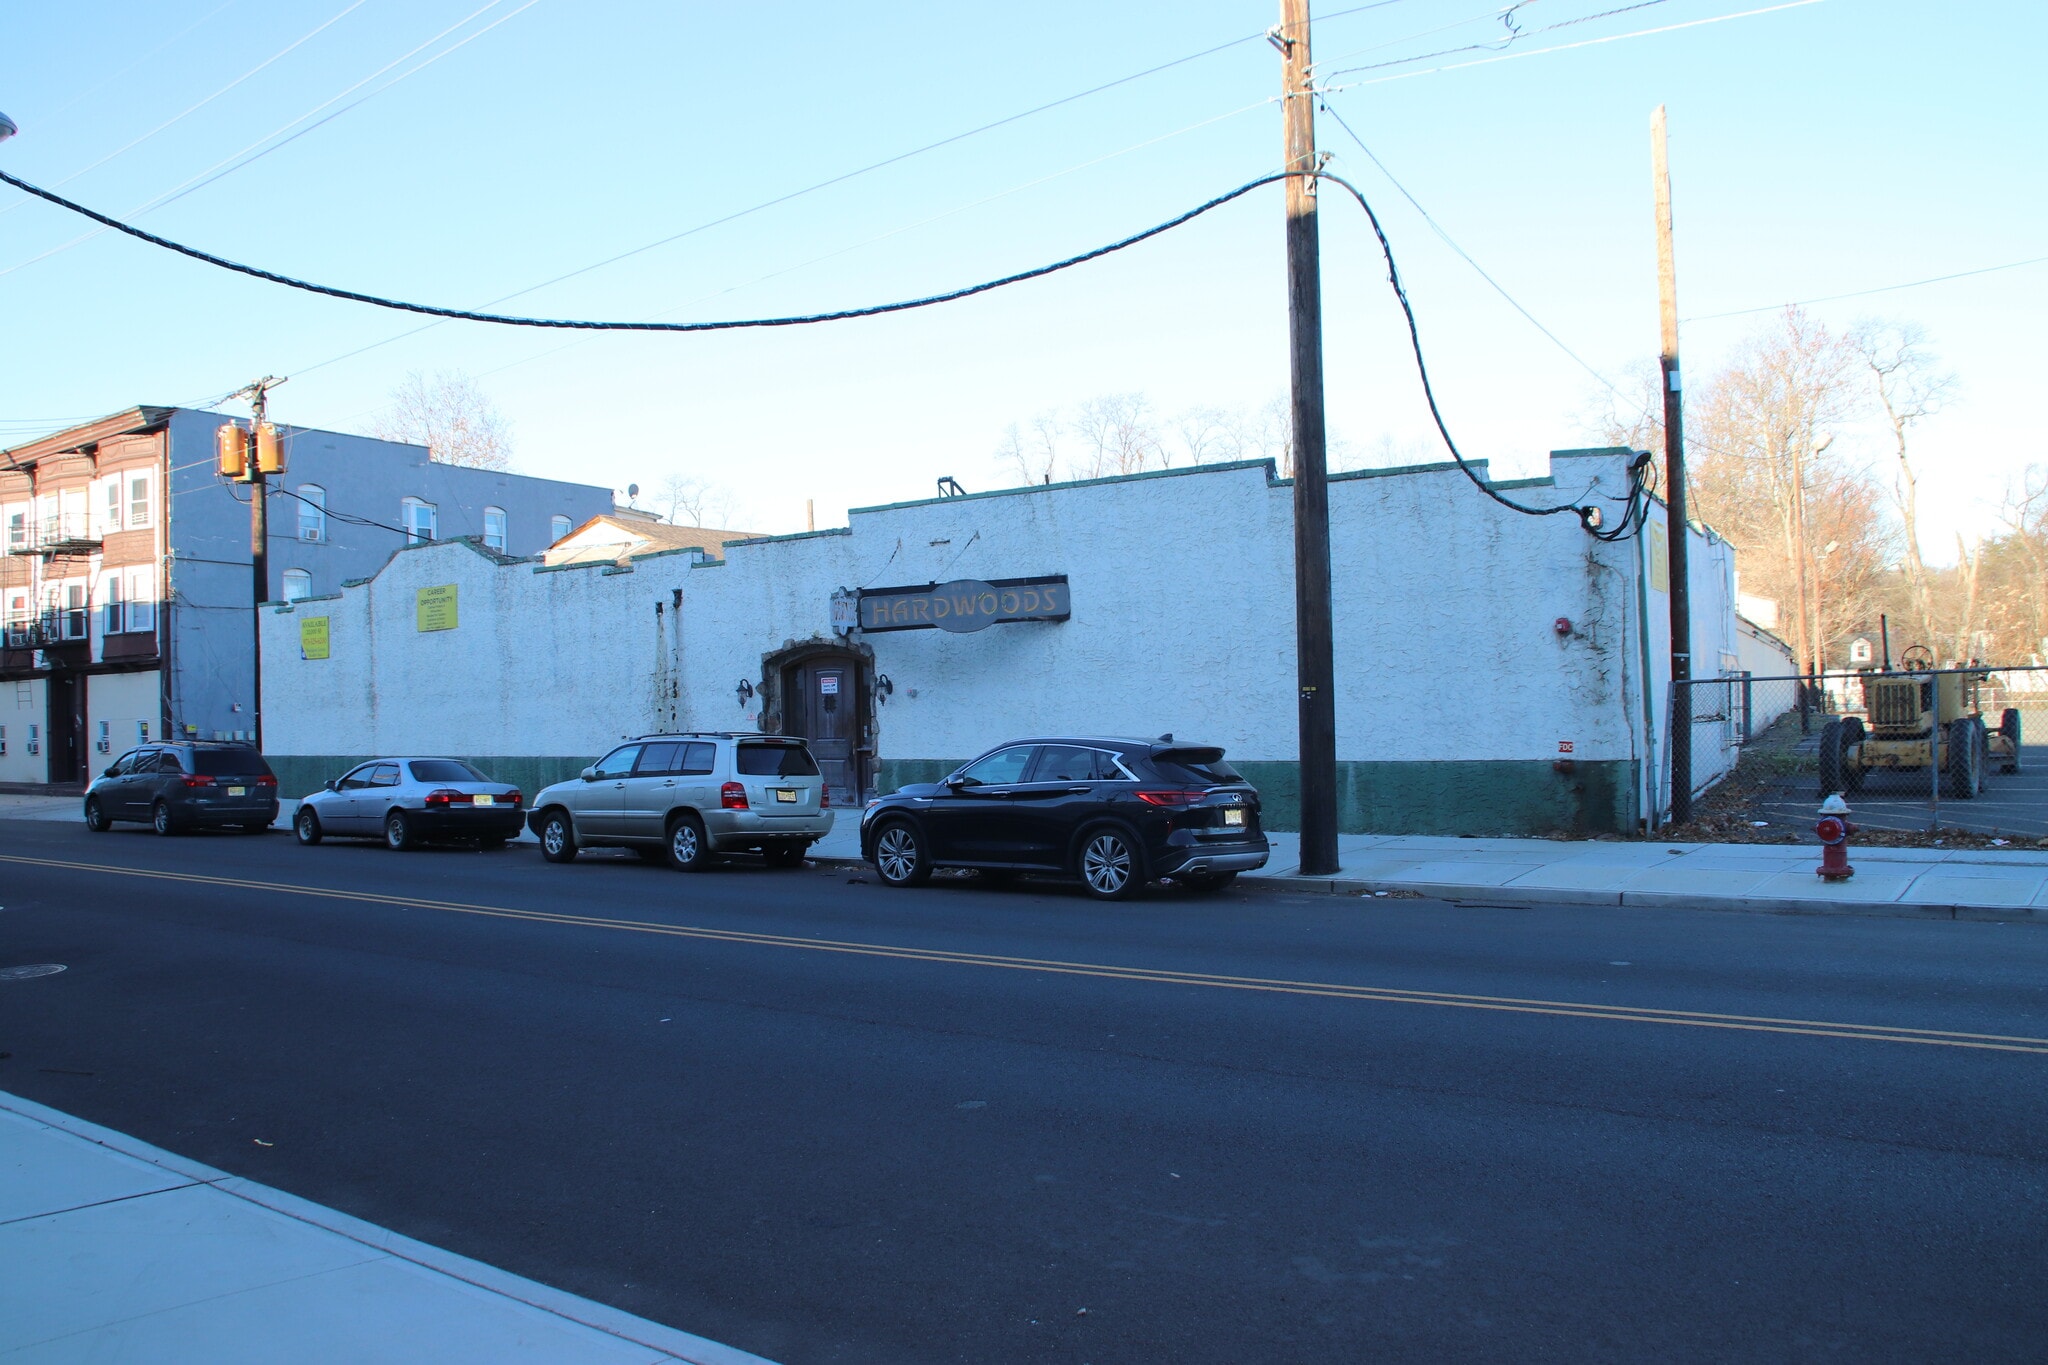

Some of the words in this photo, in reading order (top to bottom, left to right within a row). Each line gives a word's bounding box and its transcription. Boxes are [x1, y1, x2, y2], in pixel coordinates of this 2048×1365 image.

[427, 587, 446, 596] CAREER
[420, 596, 453, 606] OPPORTUNITY
[872, 588, 1057, 624] HARDWOODS
[302, 620, 327, 629] AVAILABLE
[1559, 743, 1573, 751] FDC
